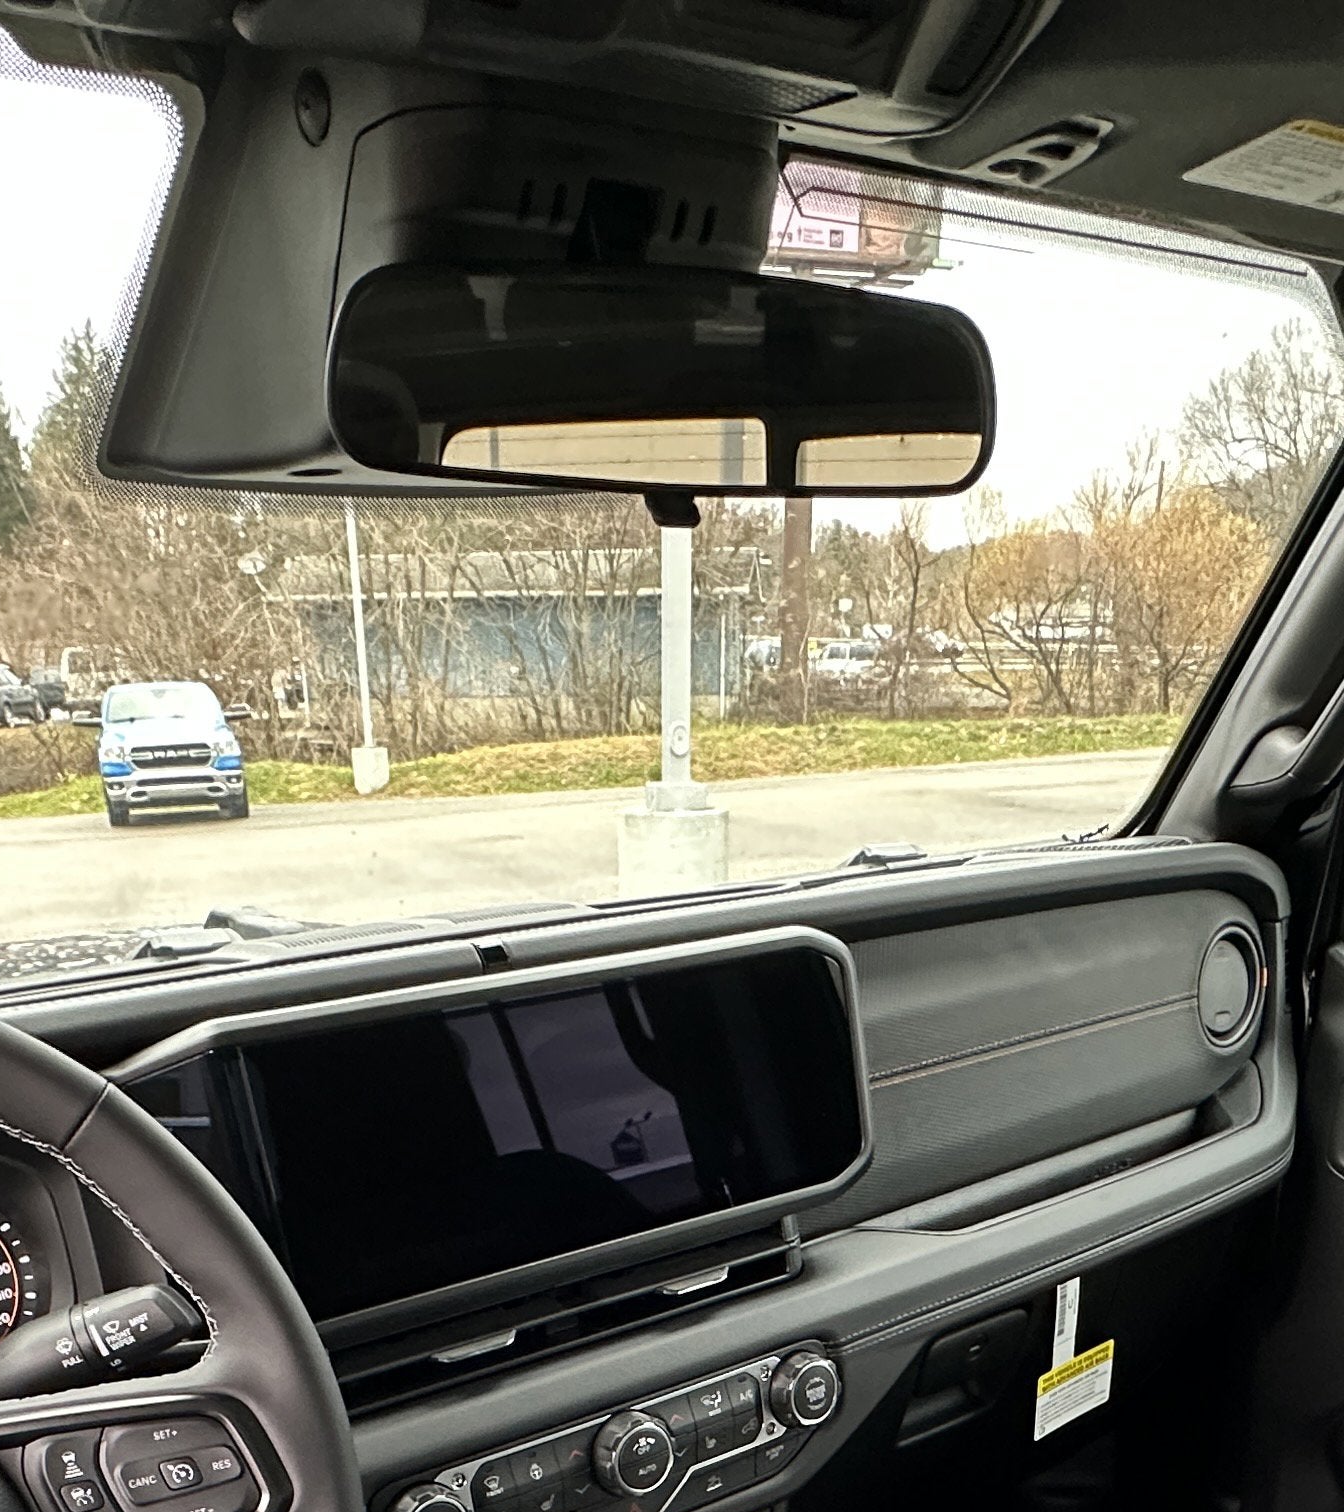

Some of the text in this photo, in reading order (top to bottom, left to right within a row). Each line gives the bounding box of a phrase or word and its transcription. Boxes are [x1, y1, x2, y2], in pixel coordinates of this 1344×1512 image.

[211, 1458, 232, 1472] RES
[638, 1463, 657, 1476] AUTO
[127, 1475, 157, 1489] CANC
